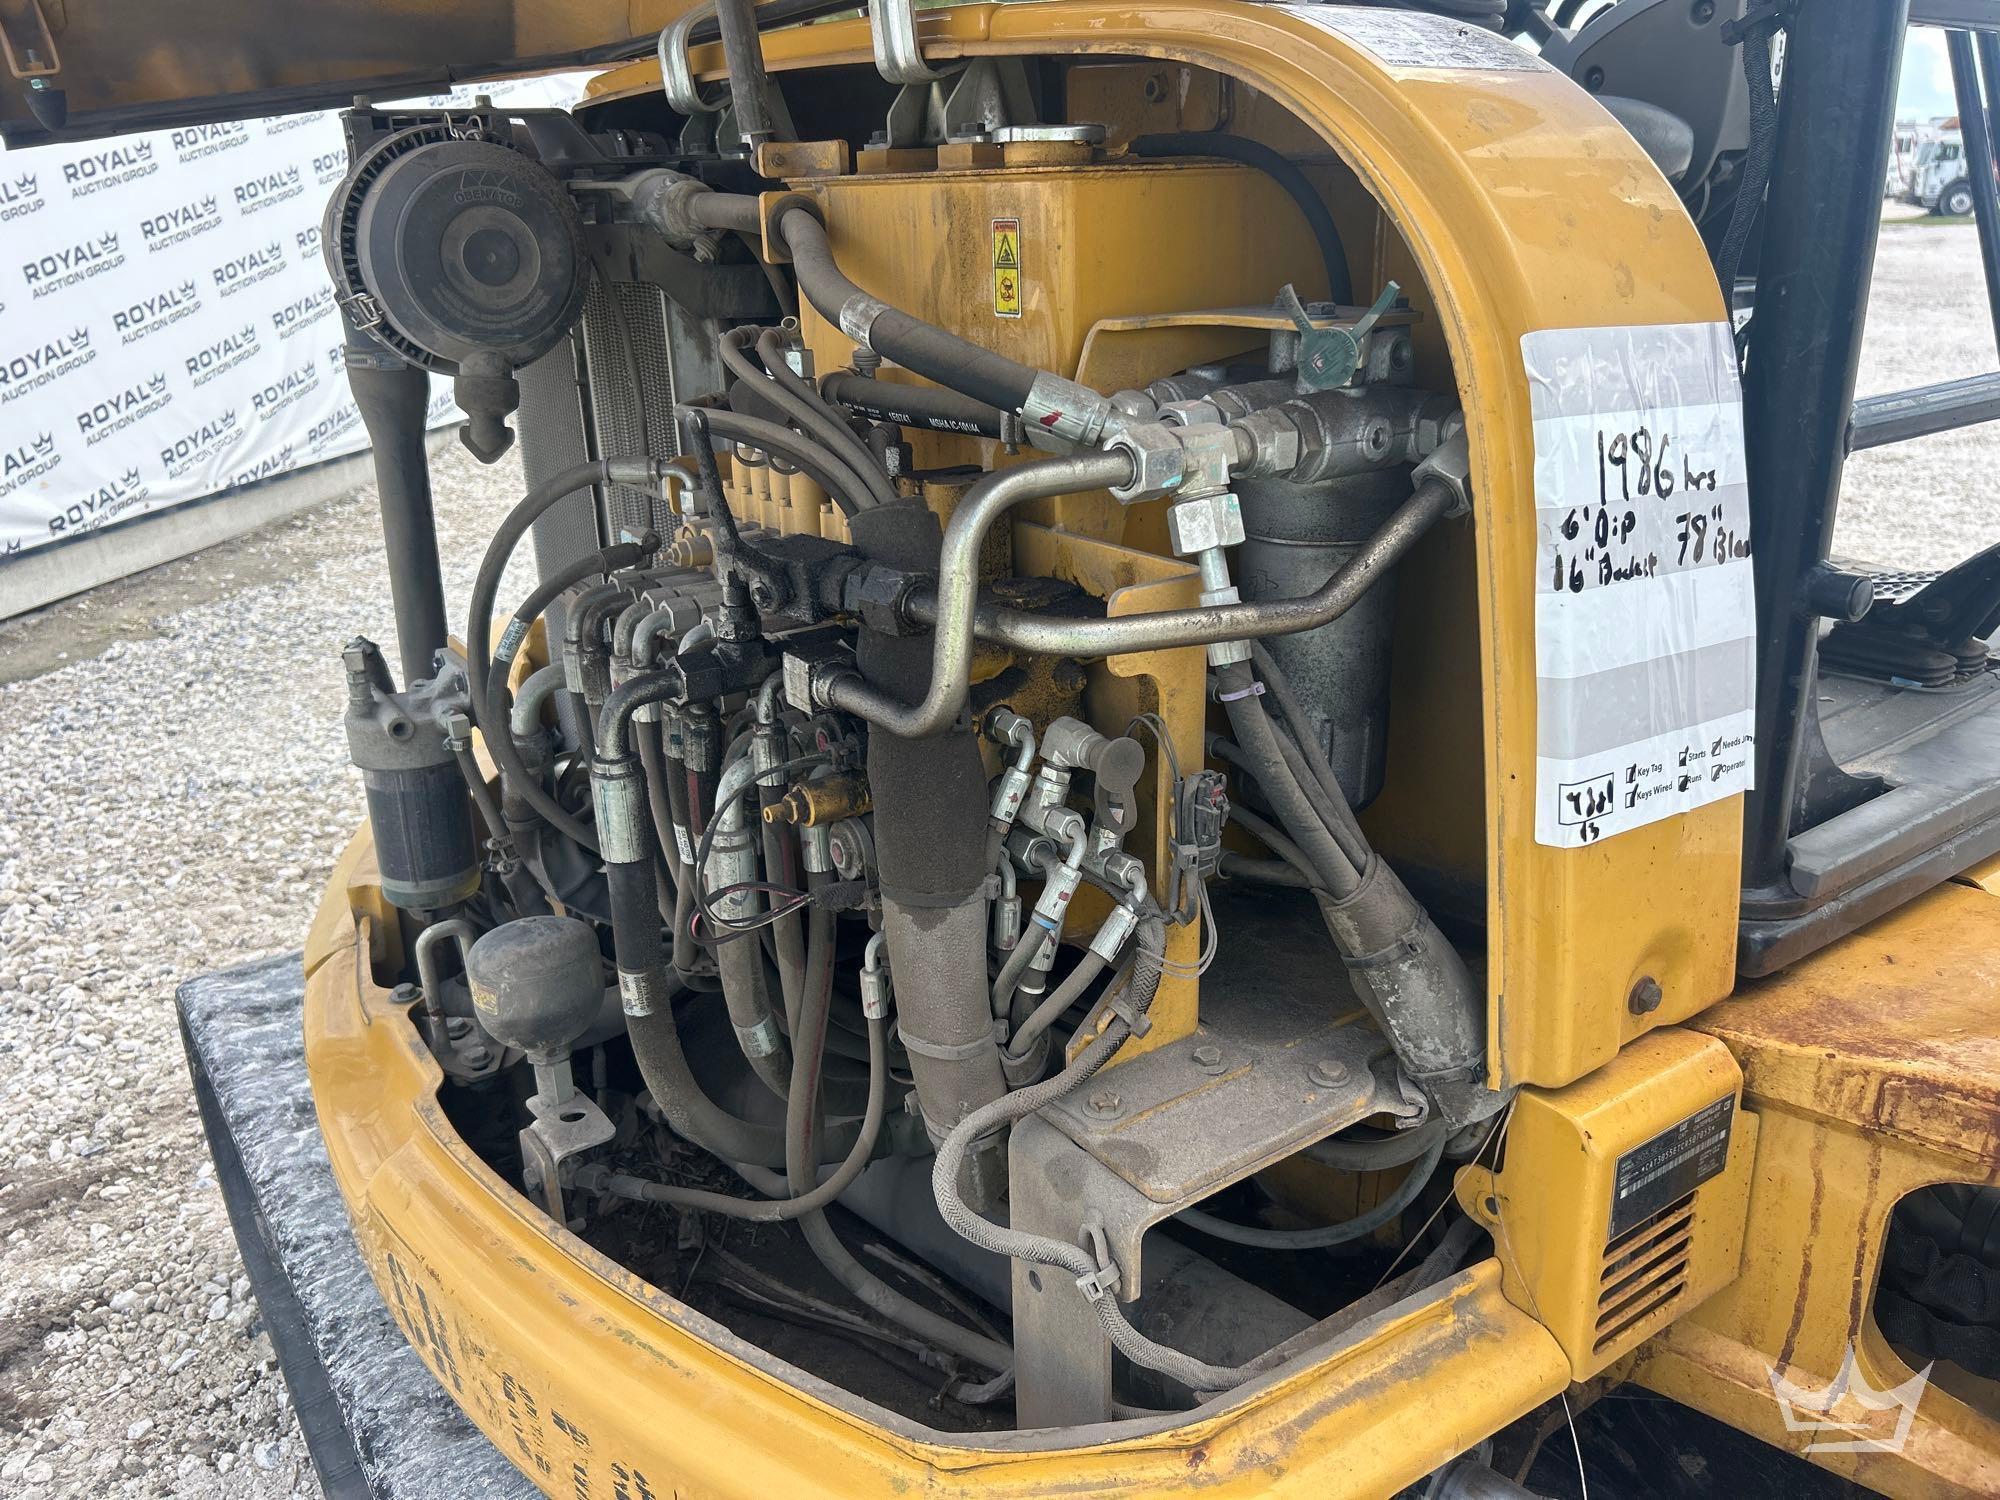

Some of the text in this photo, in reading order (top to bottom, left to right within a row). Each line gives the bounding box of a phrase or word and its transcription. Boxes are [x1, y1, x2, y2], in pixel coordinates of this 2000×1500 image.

[171, 122, 231, 150] ROYAL
[179, 134, 249, 164] AUCTION GROUP
[62, 147, 137, 183] ROYAL
[72, 162, 158, 199] AUCTION GROUP
[233, 172, 288, 203] ROYAL
[240, 184, 305, 216] AUCTION GROUP
[0, 198, 45, 221] GROUP
[140, 203, 203, 240] ROYAL
[149, 216, 222, 254] AUCTION GROUP
[22, 241, 102, 284] ROYAL
[33, 254, 125, 300] AUCTION GROUP
[213, 249, 269, 286] ROYAL
[220, 261, 287, 298] AUCTION GROUP
[112, 290, 181, 332] ROYAL
[121, 300, 201, 346] AUCTION GROUP
[272, 292, 321, 329] ROYAL
[0, 339, 72, 384] ROYAL
[185, 333, 243, 376] ROYAL
[193, 343, 260, 390] AUCTION GROUP
[1, 349, 96, 405] AUCTION GROUP
[252, 370, 306, 412] ROYAL
[77, 384, 151, 434] ROYAL
[86, 392, 173, 448] AUCTION GROUP
[260, 397, 293, 422] AUCTION
[308, 405, 353, 444] ROYAL
[161, 420, 223, 467] ROYAL
[17, 454, 62, 485] GROUP
[169, 449, 212, 479] AUCTION
[1598, 426, 1716, 506] 1986 hrs
[48, 482, 126, 536] ROYAL
[109, 488, 149, 516] GROUP
[1688, 750, 1706, 762] Starts
[1722, 737, 1741, 749] Needs
[1637, 763, 1663, 778] Key Tag
[1636, 781, 1673, 801] Keys Wired
